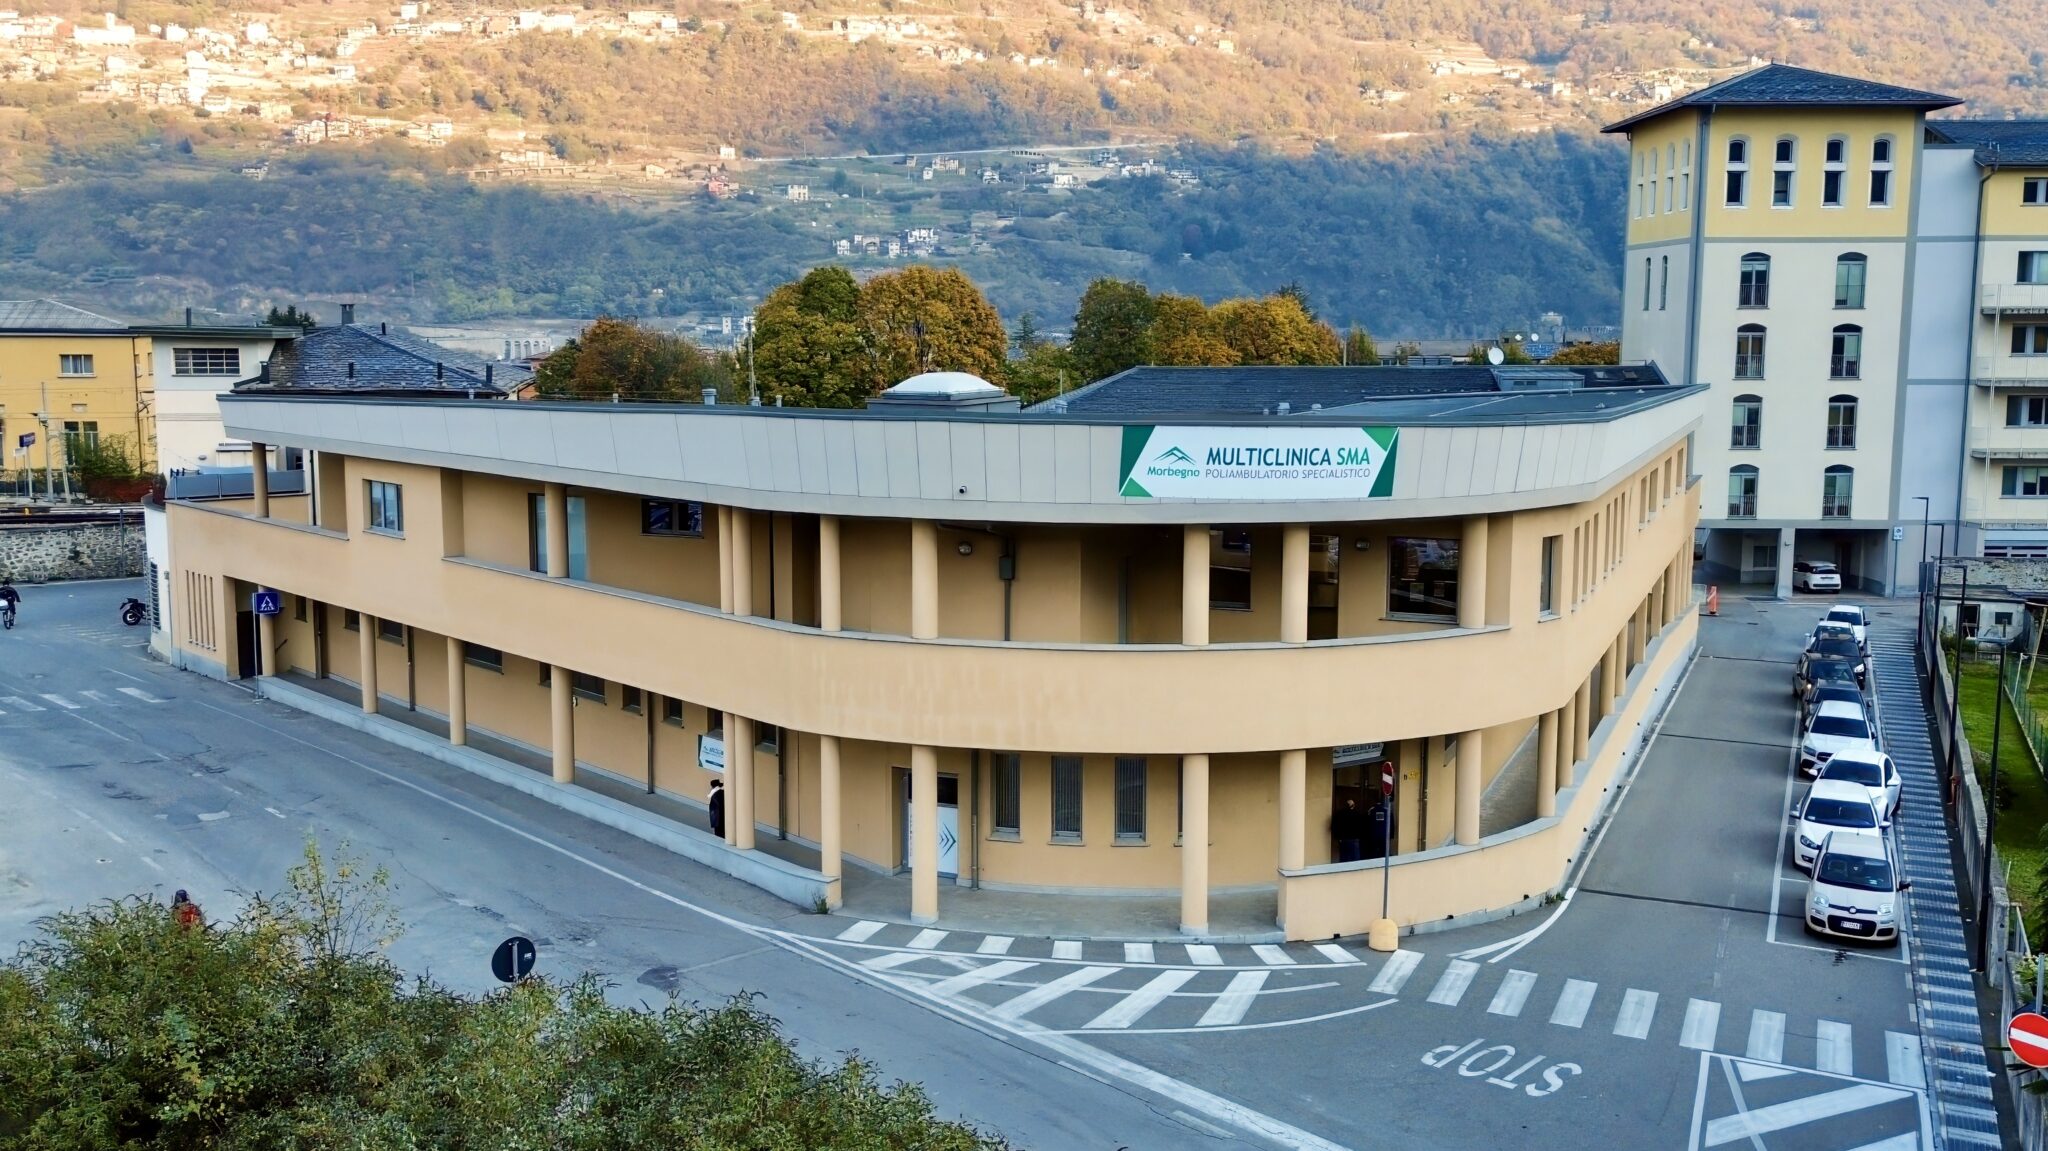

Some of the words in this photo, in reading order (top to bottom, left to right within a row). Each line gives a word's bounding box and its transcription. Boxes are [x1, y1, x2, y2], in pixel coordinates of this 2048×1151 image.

[1206, 447, 1331, 465] MULTICLINICA
[1336, 447, 1371, 465] SMA
[1147, 466, 1200, 479] Morbegno
[1205, 468, 1299, 479] POLIAMBULATORIO
[1301, 468, 1371, 479] SPECIALISTICO
[1420, 1038, 1583, 1097] STOP
